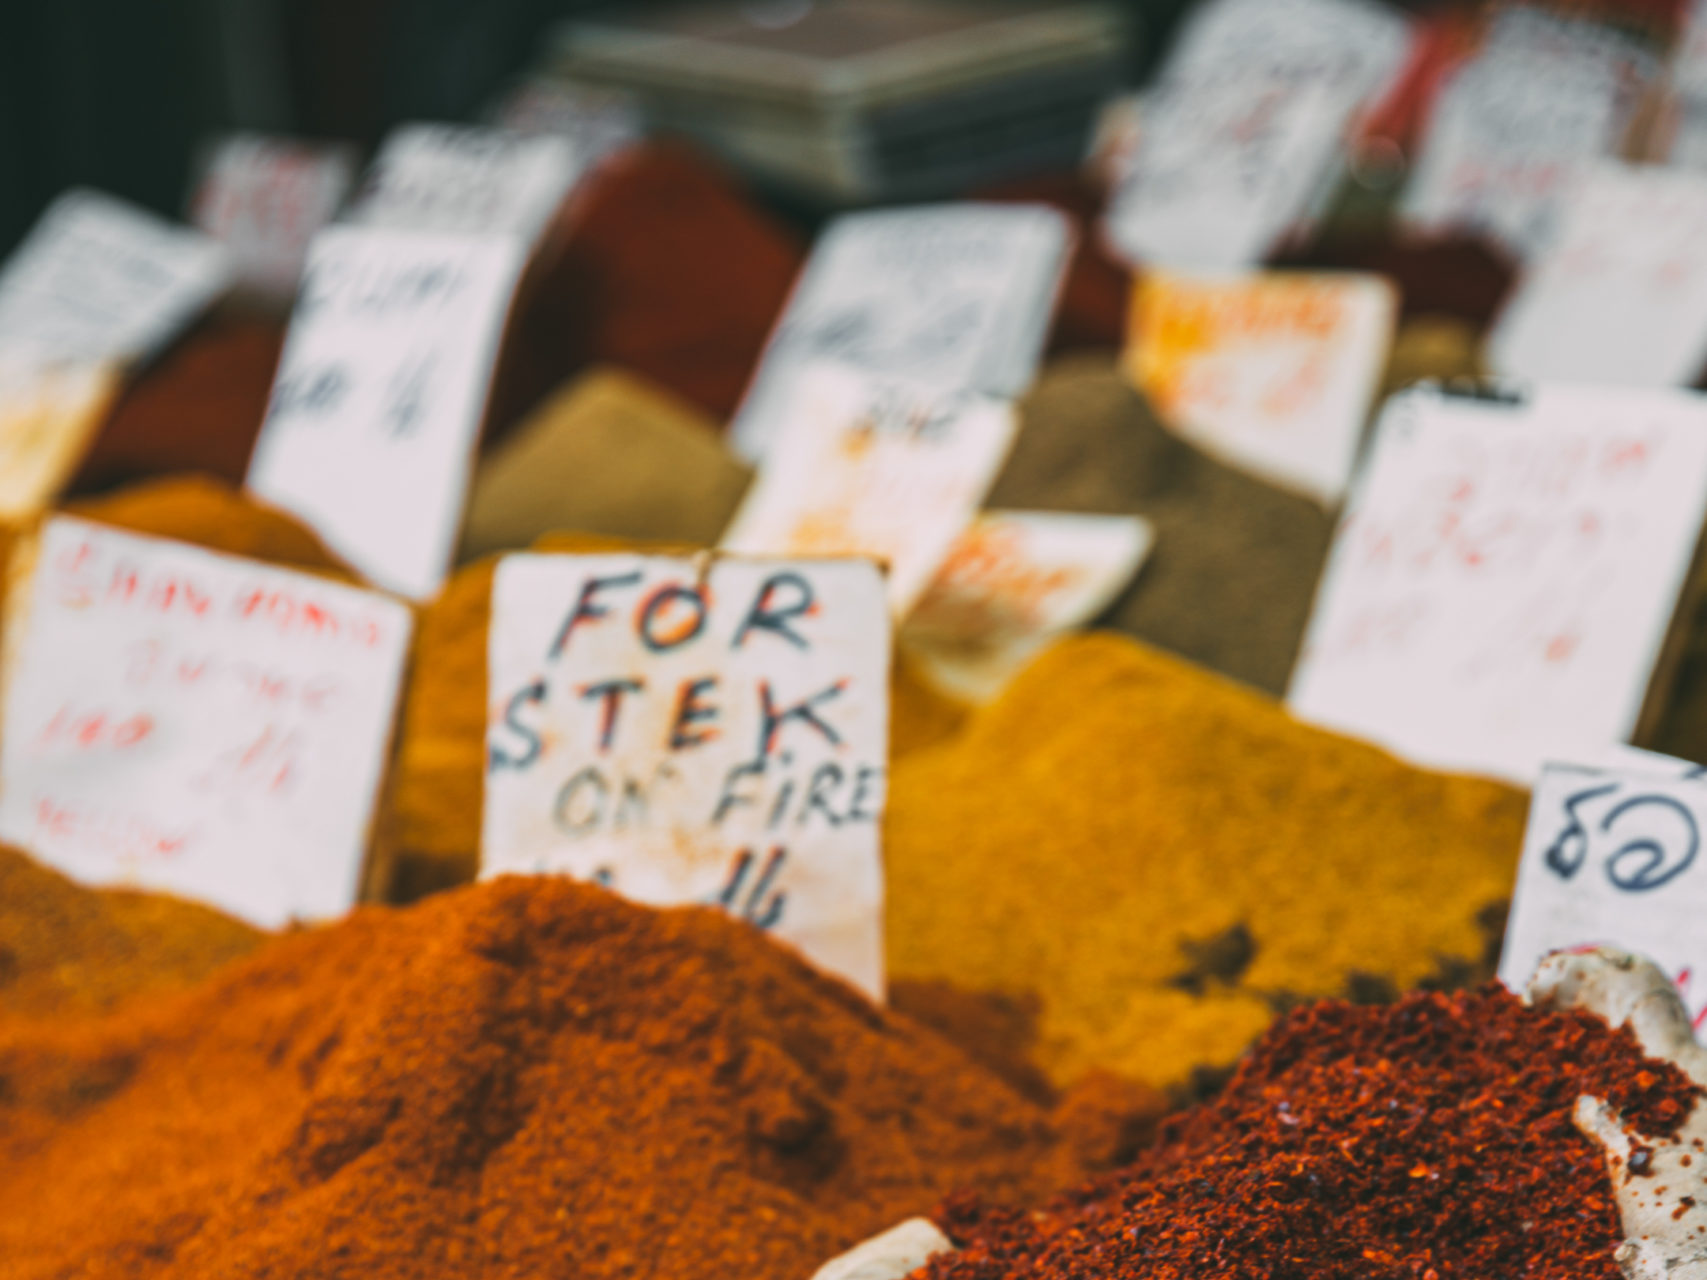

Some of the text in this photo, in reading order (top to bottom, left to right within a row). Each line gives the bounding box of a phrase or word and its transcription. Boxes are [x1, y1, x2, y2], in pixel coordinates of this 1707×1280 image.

[546, 569, 822, 663] FOR
[488, 673, 850, 772] STEK
[708, 749, 885, 831] FIRE
